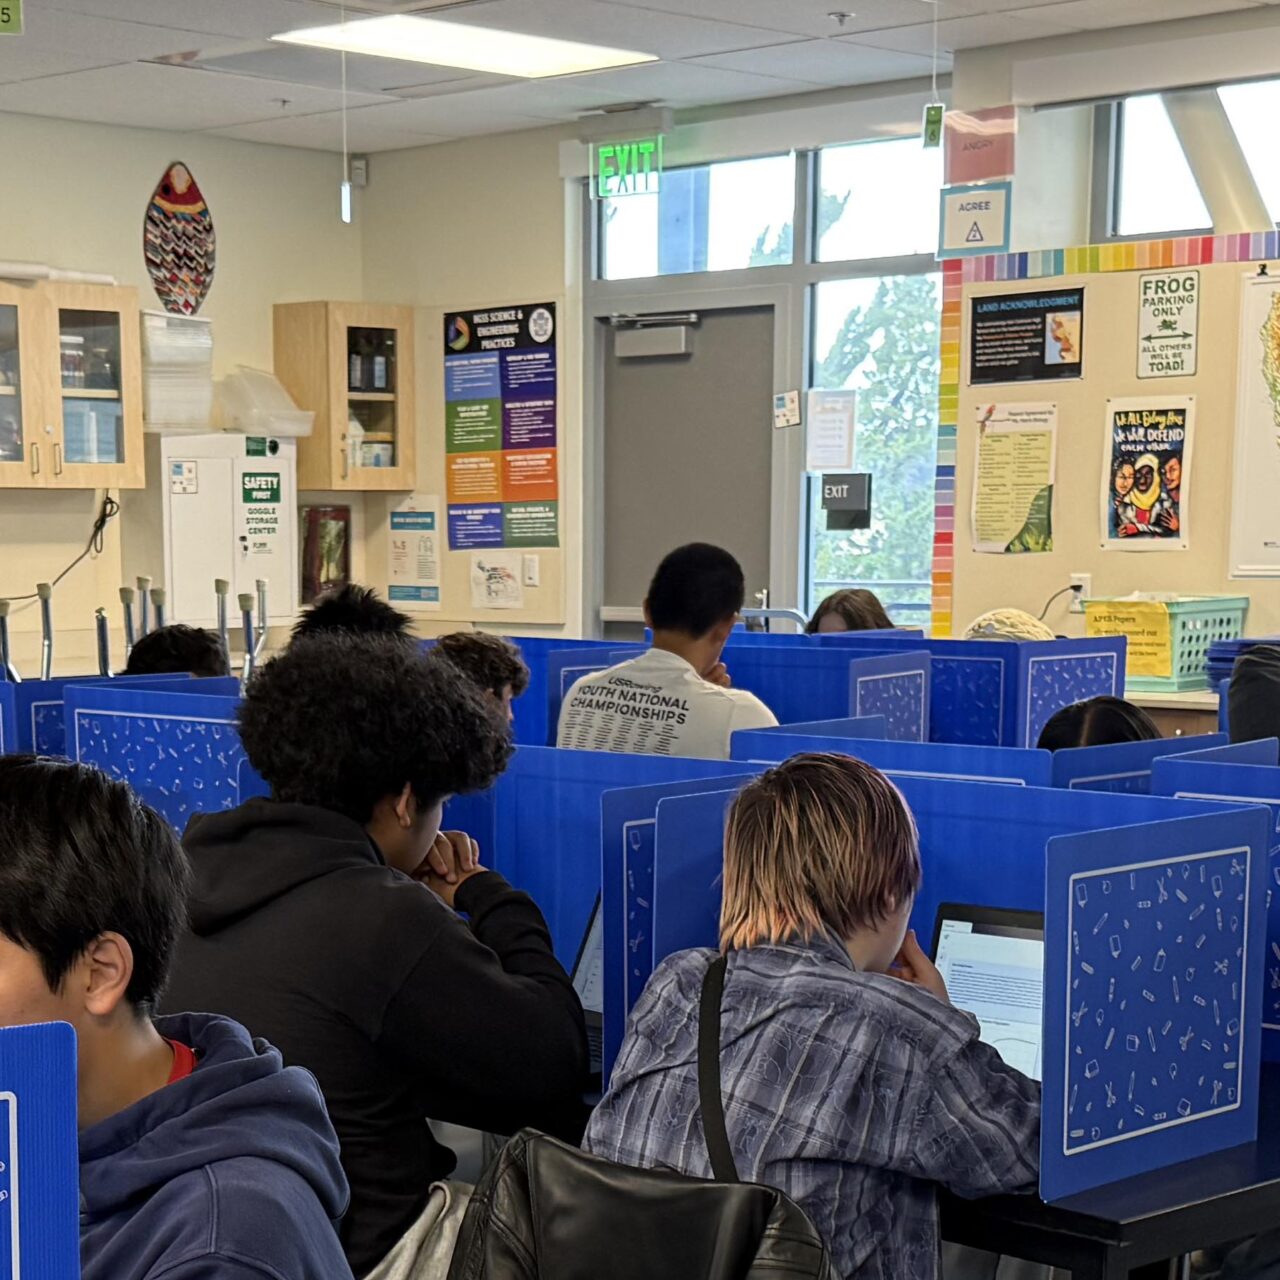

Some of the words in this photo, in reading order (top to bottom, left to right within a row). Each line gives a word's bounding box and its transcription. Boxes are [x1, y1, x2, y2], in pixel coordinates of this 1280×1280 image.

[1, 7, 11, 23] 5
[598, 142, 655, 196] EXIT
[958, 201, 991, 212] AGREE
[1142, 277, 1195, 296] FROG
[1142, 294, 1194, 308] PARKING
[1152, 306, 1183, 317] ONLY
[1142, 345, 1157, 353] ALL
[1159, 343, 1192, 352] OTHERS
[1149, 360, 1184, 372] TOAD!
[243, 476, 279, 489] SAFETY
[252, 491, 271, 500] FIRST
[824, 485, 849, 498] EXIT
[248, 527, 276, 535] CENTER
[578, 685, 617, 699] YOUTH
[618, 690, 690, 711] NATIONAL
[570, 697, 687, 725] CHAMPIONSHIPS
